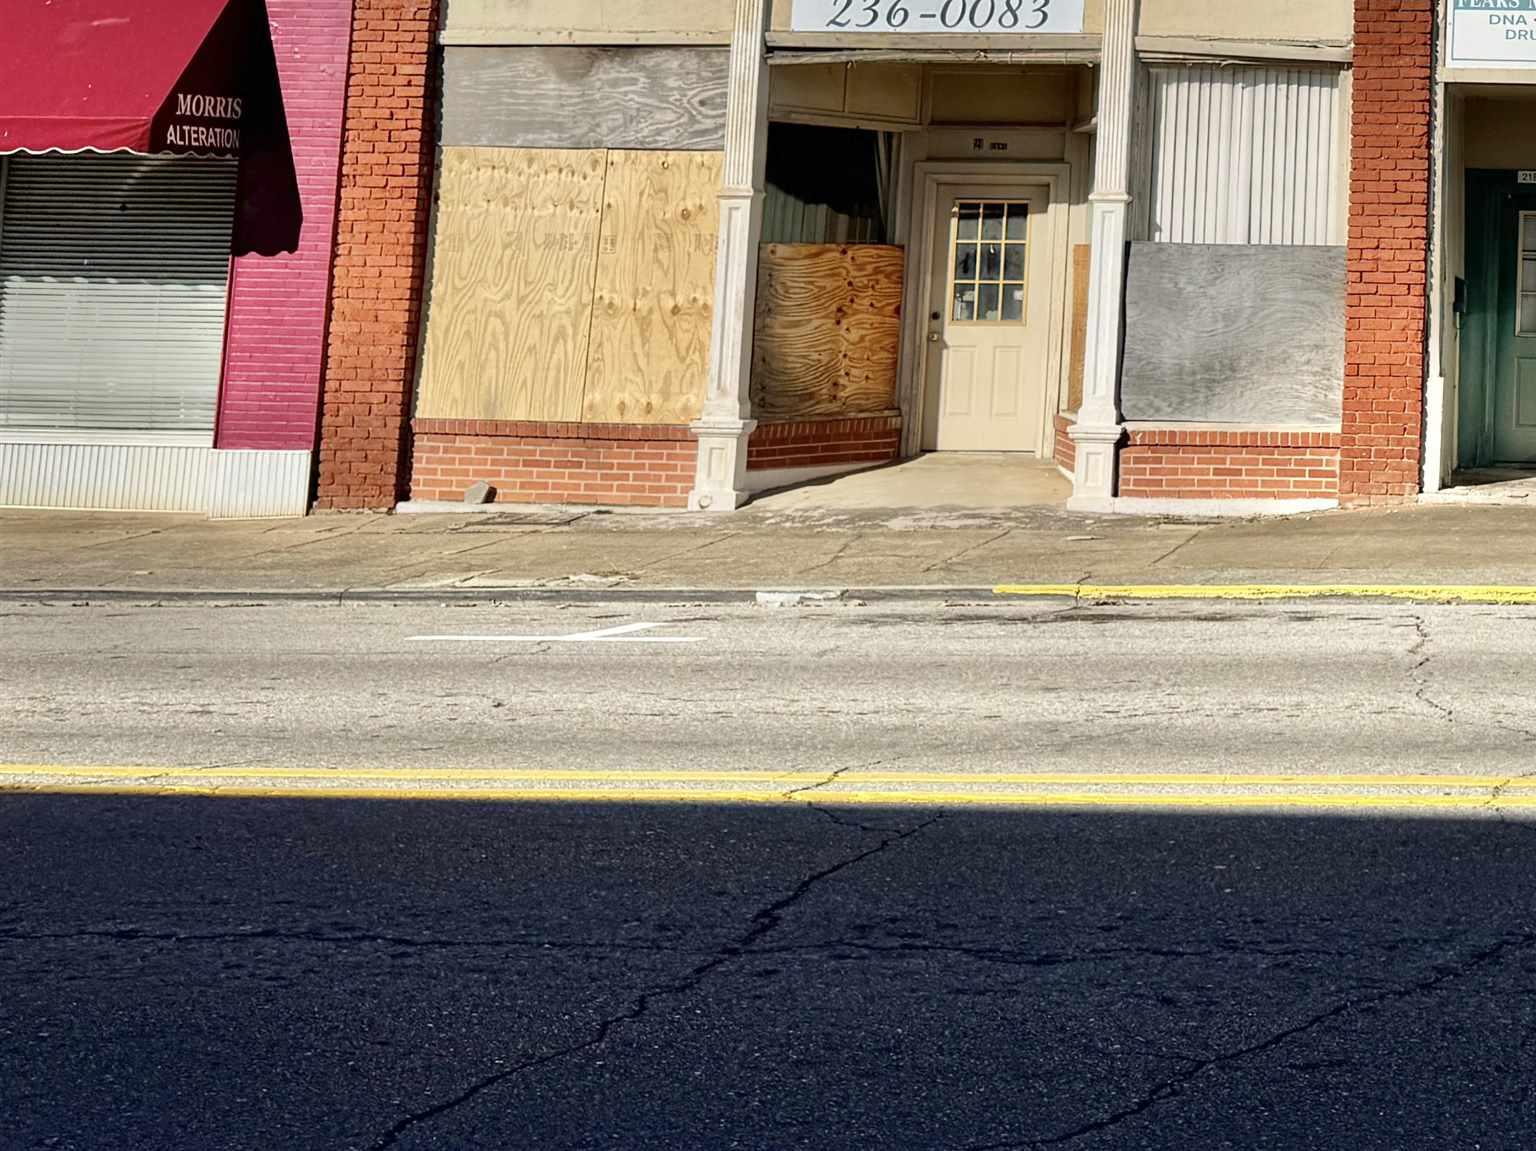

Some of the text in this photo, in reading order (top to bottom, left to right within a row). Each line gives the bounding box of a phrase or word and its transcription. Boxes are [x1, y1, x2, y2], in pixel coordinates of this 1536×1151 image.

[1488, 14, 1528, 26] DNA
[176, 93, 242, 119] MORRIS
[166, 125, 240, 148] ALTERATION
